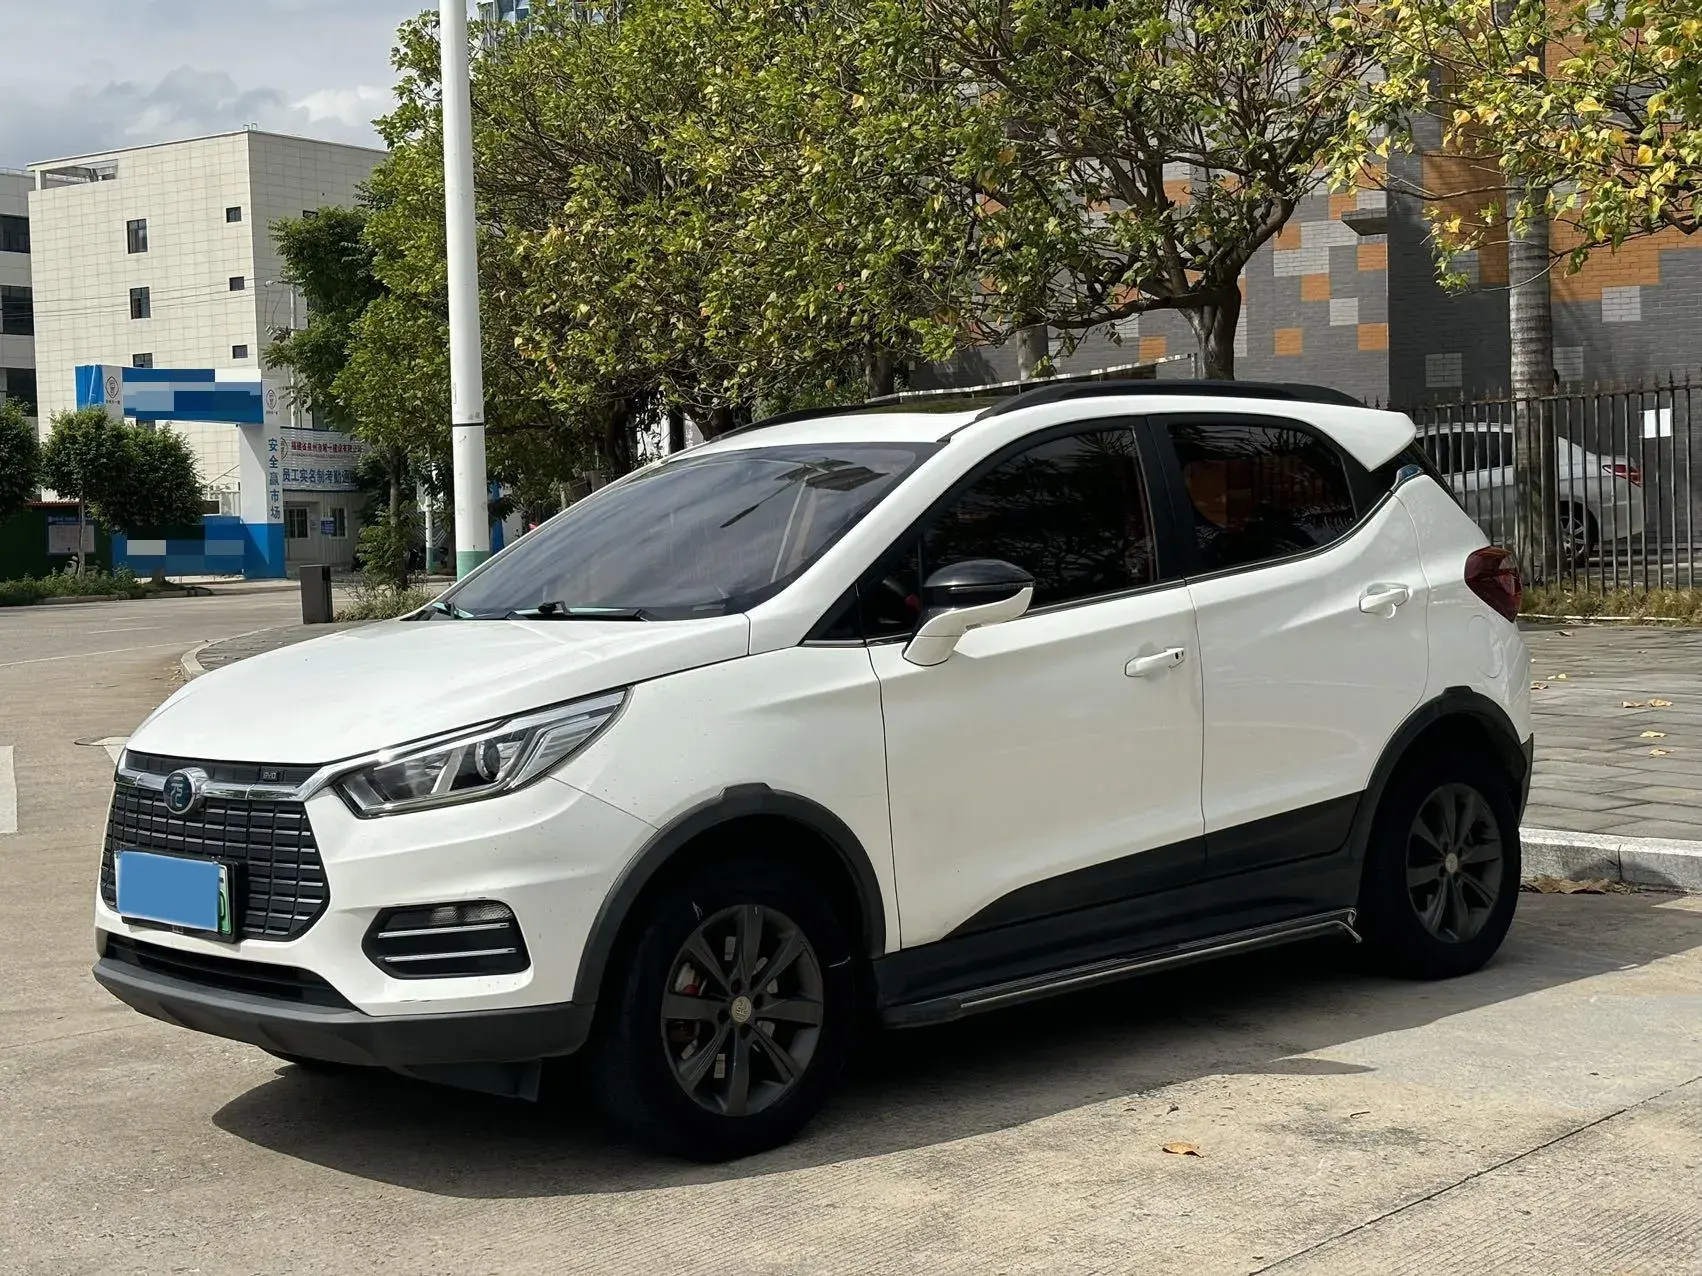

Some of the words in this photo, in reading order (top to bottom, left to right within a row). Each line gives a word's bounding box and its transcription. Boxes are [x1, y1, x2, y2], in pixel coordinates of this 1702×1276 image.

[268, 438, 280, 519] 安全赢市场
